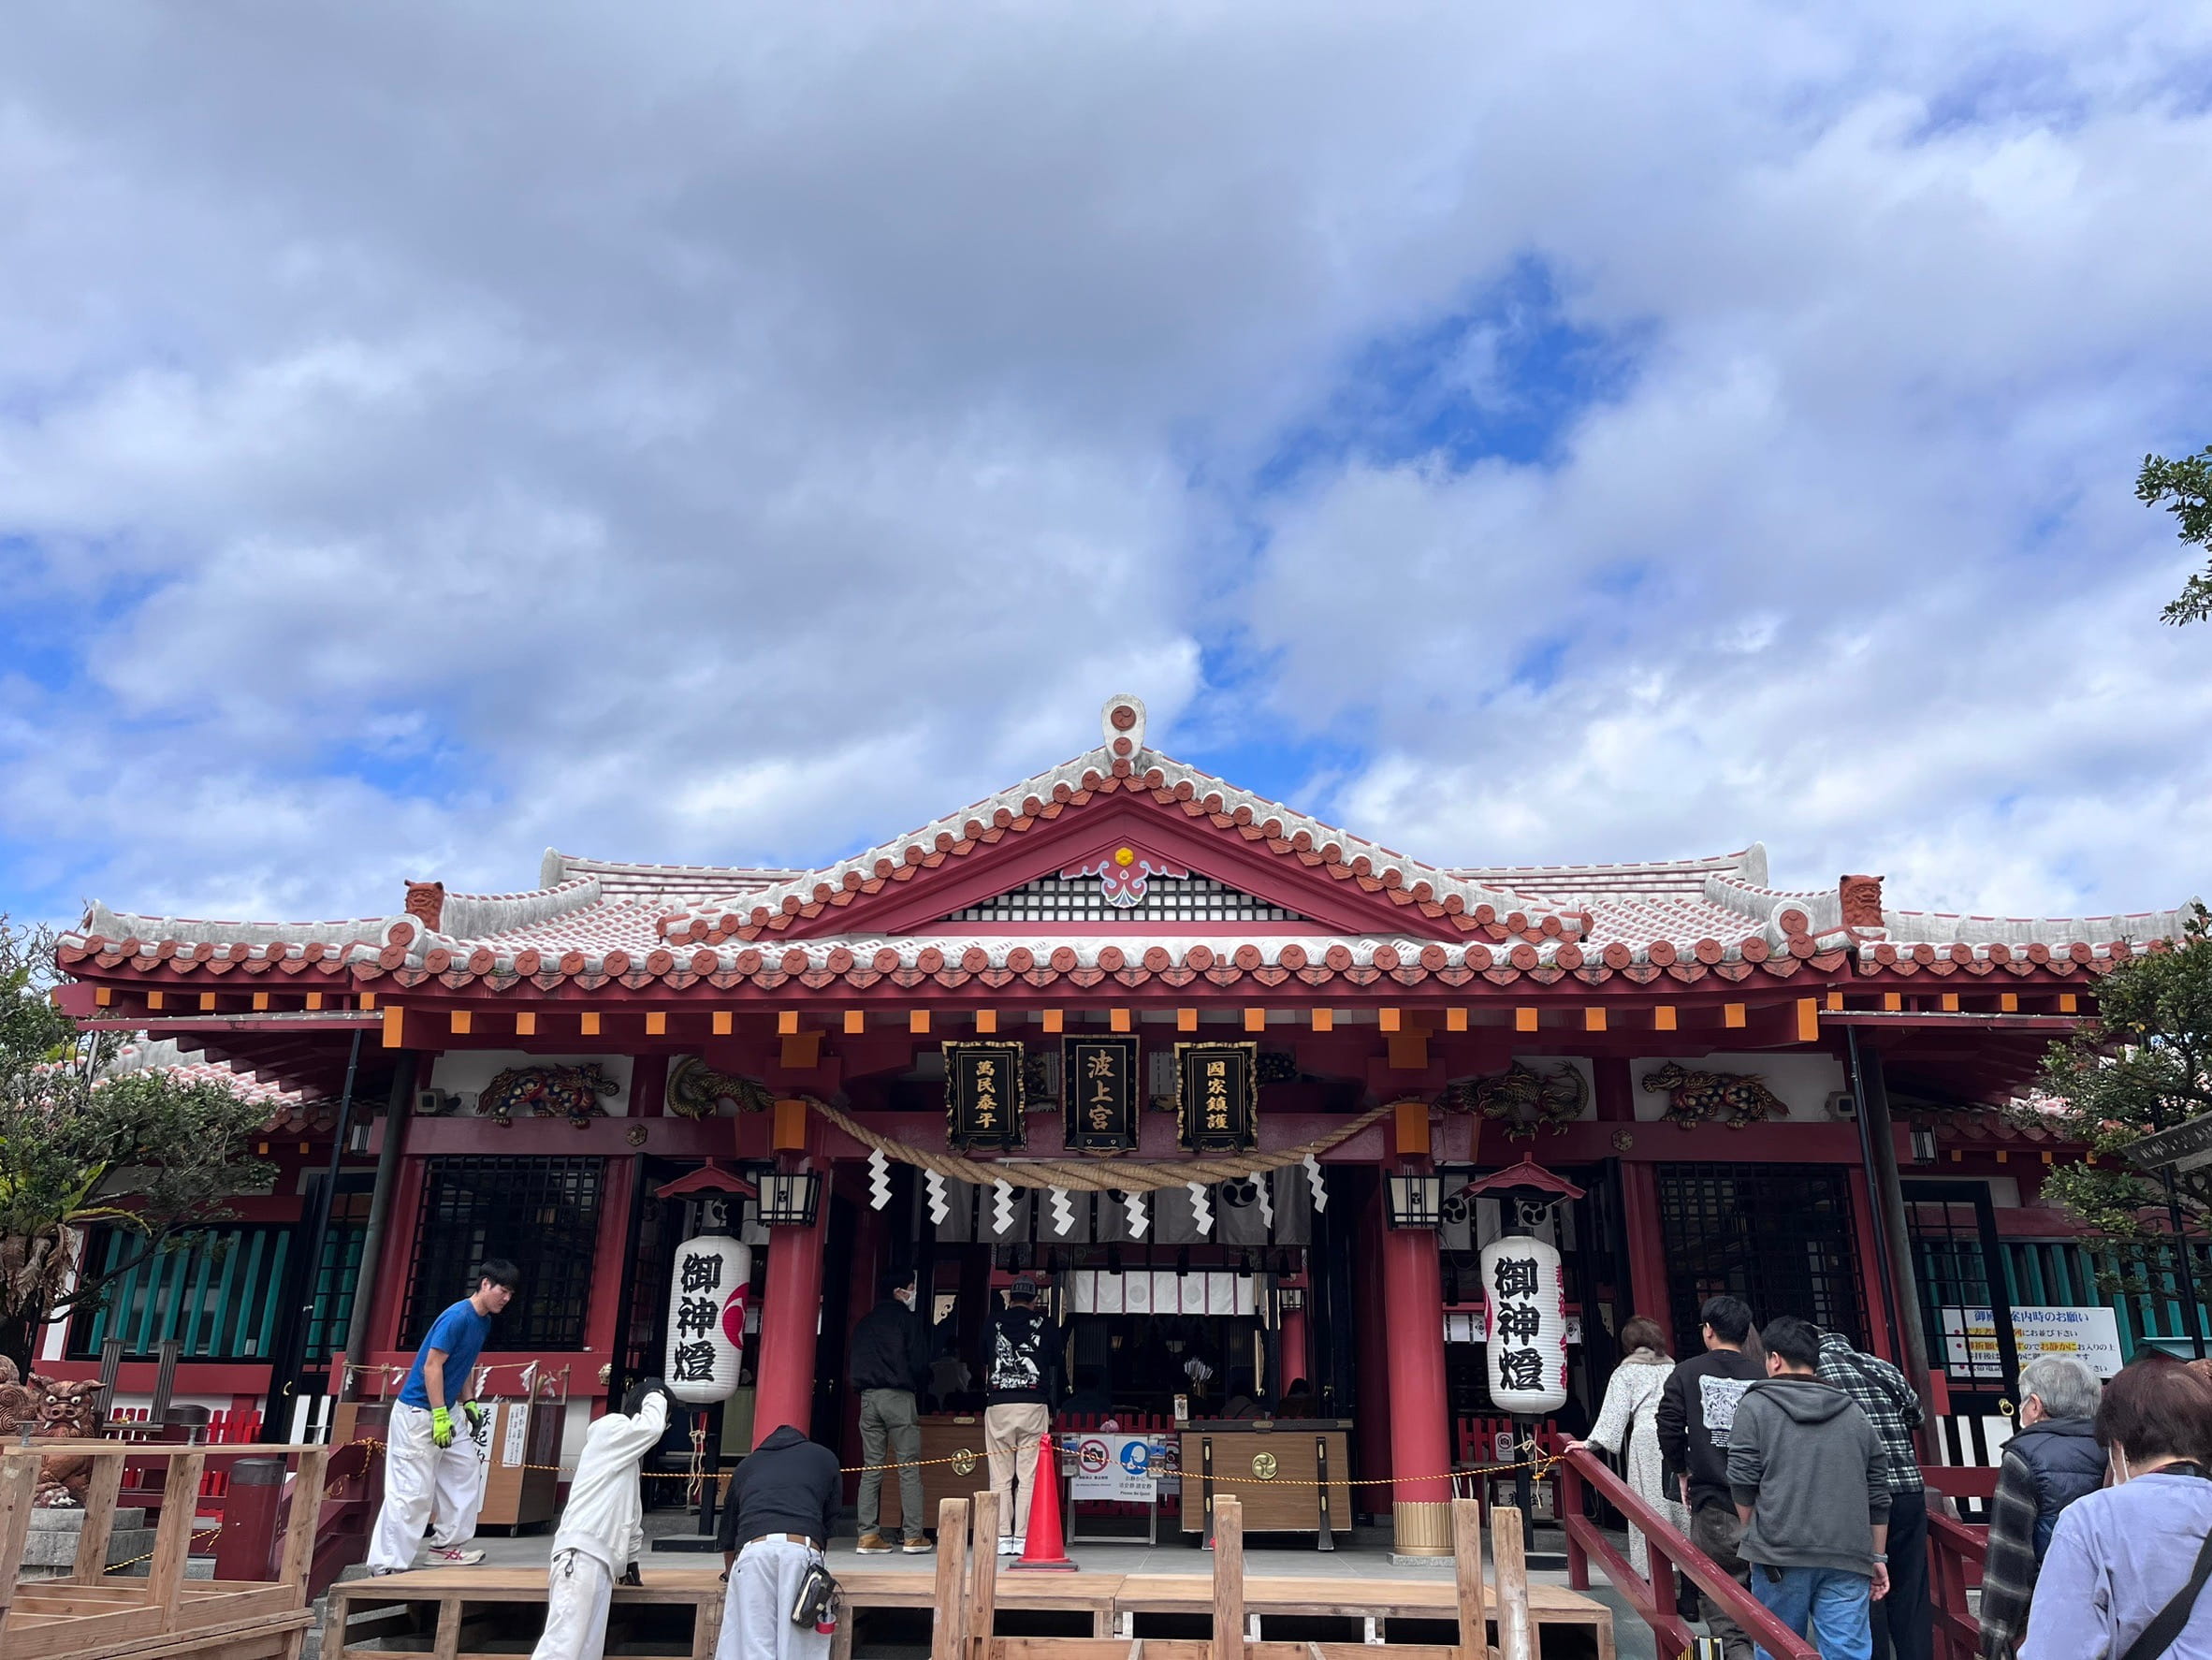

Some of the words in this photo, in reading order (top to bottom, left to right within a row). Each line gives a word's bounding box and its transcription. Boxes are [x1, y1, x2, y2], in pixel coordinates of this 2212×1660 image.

[975, 1059, 998, 1129] 萬民泰平
[1086, 1049, 1116, 1130] 波上宮
[1205, 1060, 1229, 1129] 國家鎮護
[673, 1252, 724, 1383] 御神燈
[1494, 1257, 1546, 1392] 御神燈
